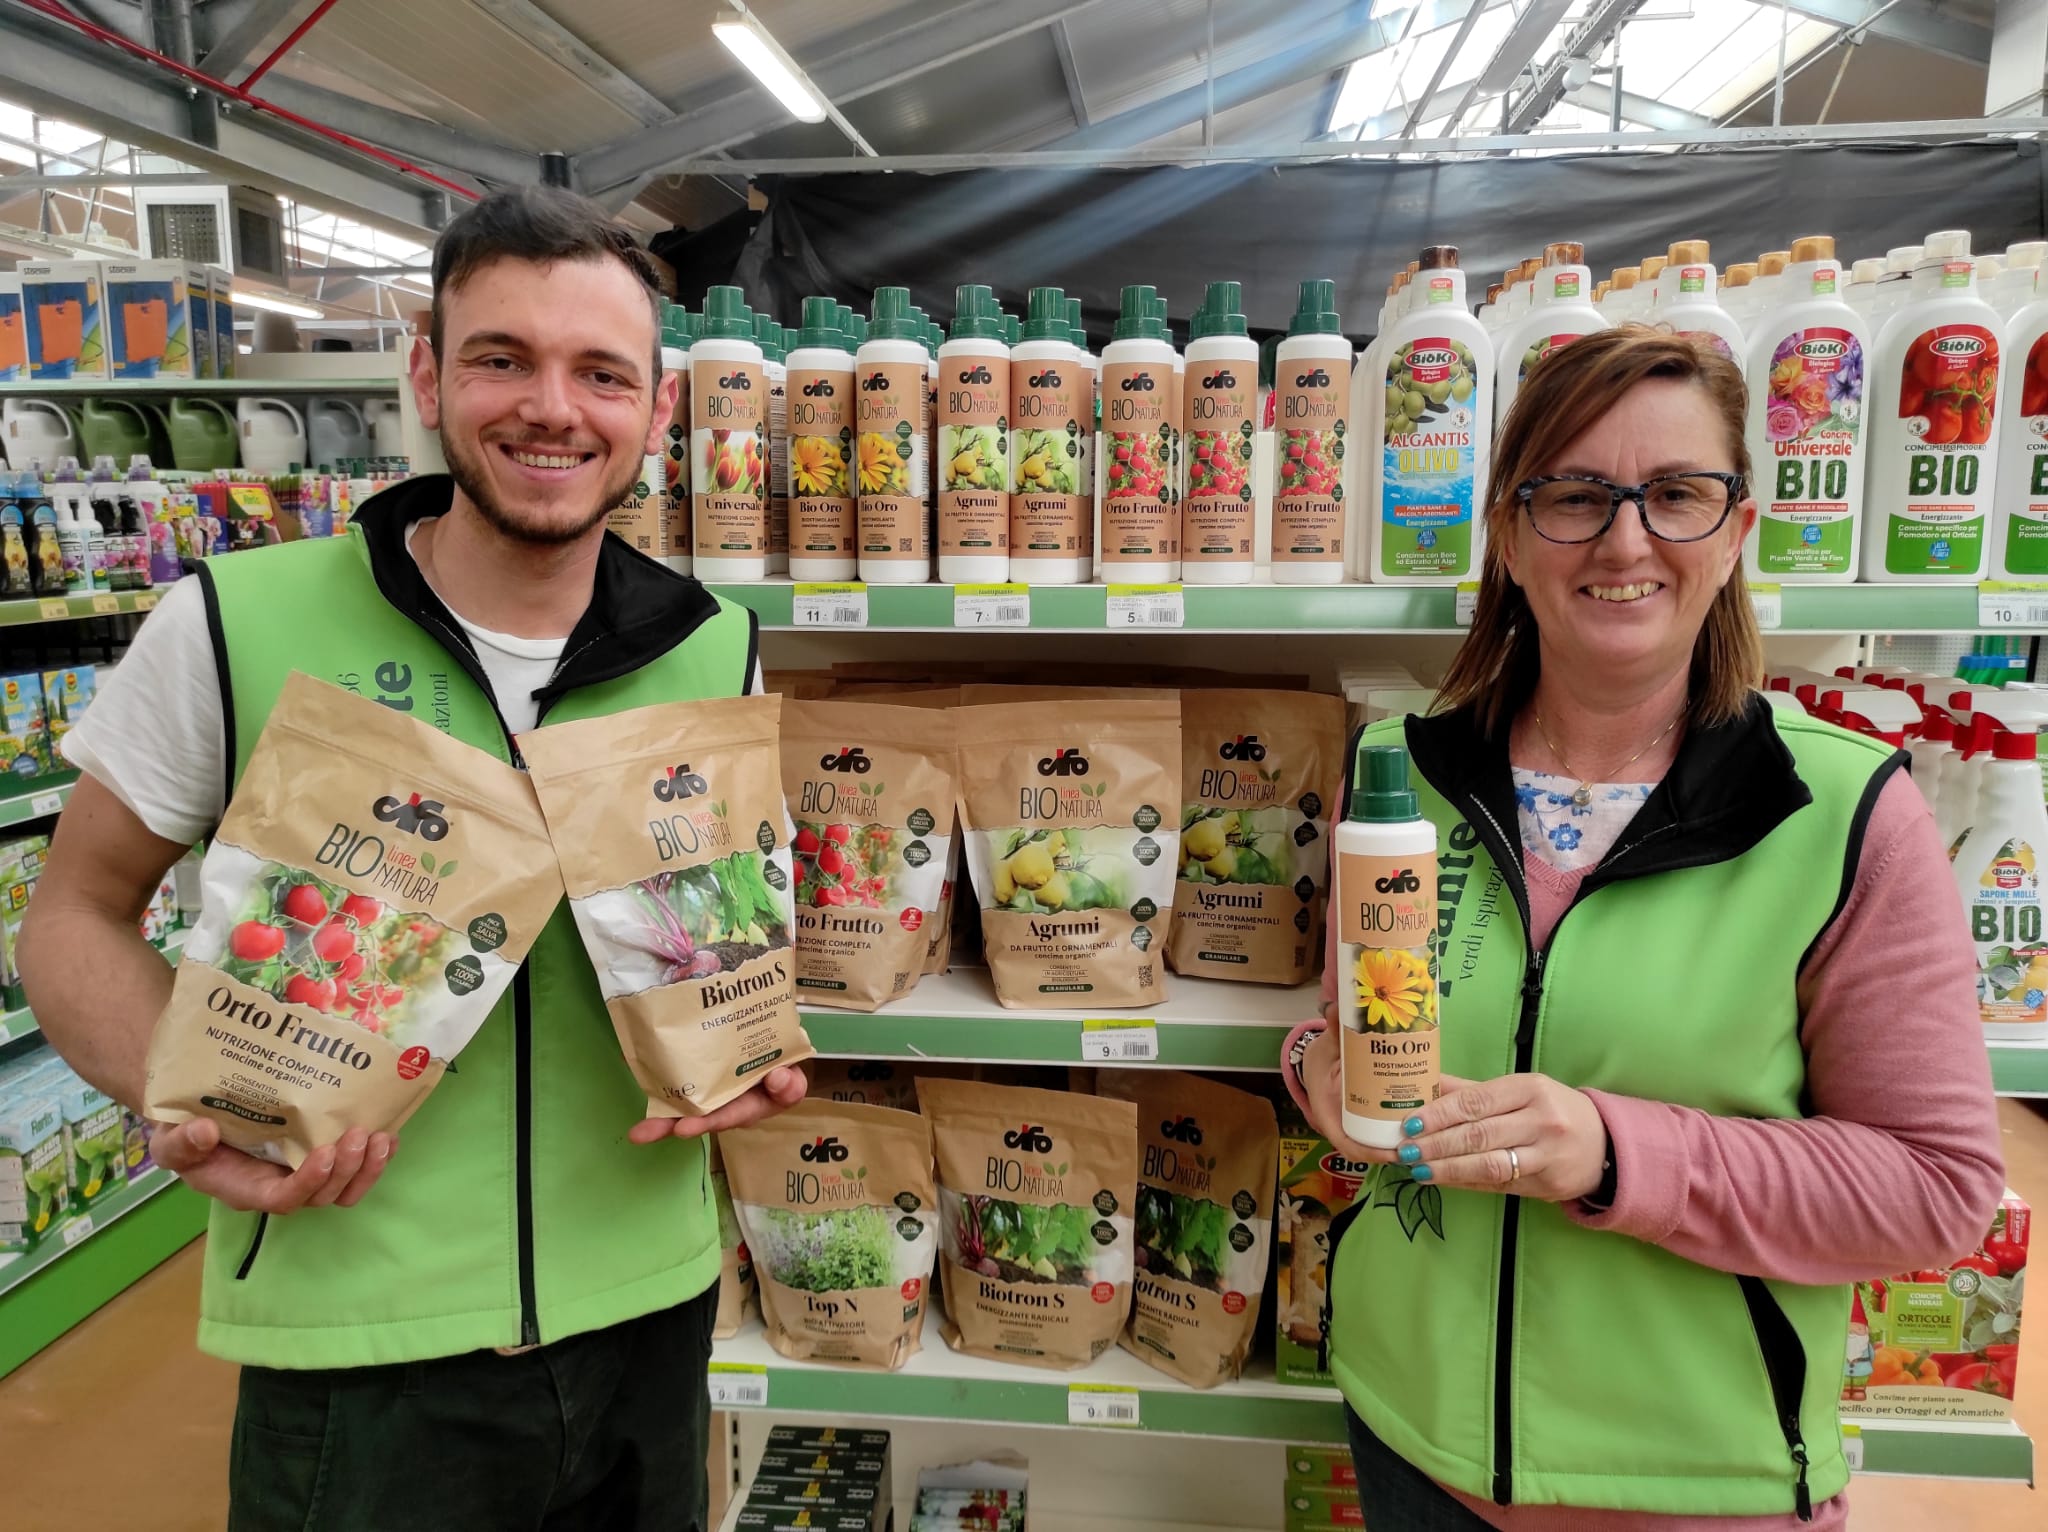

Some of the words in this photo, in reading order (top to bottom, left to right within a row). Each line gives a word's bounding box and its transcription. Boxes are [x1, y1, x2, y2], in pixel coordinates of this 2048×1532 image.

[719, 371, 751, 390] cifo
[862, 373, 890, 391] cifo
[959, 366, 992, 384] cifo
[1029, 370, 1062, 389] cifo
[1121, 372, 1154, 391] cifo
[1203, 370, 1236, 389] cifo
[1296, 368, 1330, 388] cifo
[803, 379, 834, 397] cifo
[708, 396, 732, 417] BIO
[950, 391, 971, 413] BIO
[974, 402, 999, 413] NATURA
[1020, 396, 1041, 417] BIO
[1043, 404, 1068, 416] NATURA
[1111, 399, 1134, 420] BIO
[1135, 405, 1161, 420] NATURA
[1193, 397, 1215, 419] BIO
[1216, 403, 1242, 417] NATURA
[1285, 396, 1309, 418] BIO
[1309, 404, 1336, 417] NATURA
[794, 404, 815, 424] BIO
[817, 412, 841, 424] NATURA
[871, 407, 898, 419] NATURA
[1392, 433, 1469, 448] ALGANTIS
[1821, 431, 1853, 439] Concime
[1774, 441, 1852, 457] Universale
[1400, 450, 1459, 473] OLIVO
[1776, 460, 1848, 500] BIO
[1909, 455, 1979, 496] BIO
[706, 499, 762, 511] Universale
[800, 502, 818, 512] Bio
[820, 502, 841, 512] Oro
[875, 501, 898, 512] Oro
[954, 496, 998, 511] Agrumi
[1023, 499, 1066, 513] Agrumi
[1106, 503, 1130, 513] Orto
[1133, 503, 1167, 514] Frutto
[1187, 503, 1211, 513] Orto
[1214, 503, 1248, 513] Frutto
[1278, 502, 1303, 512] Orto
[1306, 502, 1340, 512] Frutto
[806, 611, 819, 621] 11
[975, 612, 982, 622] 7
[1128, 612, 1135, 623] 5
[1995, 610, 2012, 621] 10
[430, 673, 450, 734] azioni
[1219, 735, 1266, 762] cifo
[820, 748, 871, 773] cifo
[1038, 749, 1089, 776] cifo
[654, 764, 707, 802] cifo
[838, 784, 857, 795] linea
[1060, 787, 1079, 798] linea
[1200, 769, 1237, 800] BIO
[1237, 782, 1276, 801] NATURA
[801, 781, 835, 814] BIO
[836, 797, 877, 817] NATURA
[1020, 787, 1058, 820] BIO
[373, 792, 449, 841] cifo
[1060, 799, 1103, 818] NATURA
[649, 815, 698, 861] BIO
[315, 823, 385, 878] BIO
[387, 845, 416, 869] linea
[373, 862, 439, 905] NATURA
[1375, 869, 1420, 894] cifo
[1192, 889, 1262, 910] Agrumi
[1437, 822, 1480, 997] iante
[796, 913, 816, 929] rto
[821, 914, 883, 934] Frutto
[1188, 912, 1216, 920] FRUTTO
[1224, 915, 1279, 925] ORNAMENTALI
[1361, 903, 1394, 932] BIO
[1397, 912, 1429, 931] NATURA
[1460, 936, 1484, 980] verdi
[1472, 866, 1503, 928] ispirazi
[1972, 906, 2042, 942] BIO
[476, 926, 496, 940] SALVA
[1026, 916, 1099, 942] Agrumi
[796, 936, 826, 945] RIZIONE
[829, 940, 871, 949] COMPLETA
[1062, 941, 1117, 951] ORNAMENTALI
[455, 969, 476, 983] 100%
[701, 971, 774, 1009] Biotron
[775, 962, 786, 982] S
[702, 1002, 763, 1030] ENERGIZZANTE
[736, 1011, 777, 1031] ammendante
[207, 987, 272, 1030] Orto
[275, 1013, 371, 1070] Frutto
[206, 1026, 277, 1061] NUTRIZIONE
[277, 1055, 341, 1088] COMPLETA
[1103, 1046, 1109, 1056] 9
[1371, 1040, 1397, 1055] Bio
[1402, 1040, 1430, 1055] Oro
[221, 1048, 264, 1070] concime
[266, 1066, 312, 1089] organico
[1374, 1061, 1428, 1069] BIOSTIMOLANTE
[229, 1082, 280, 1106] AGRICOLTURA
[231, 1073, 278, 1095] CONSENTITO
[213, 1099, 272, 1122] GRANULARE
[226, 1093, 267, 1111] BIOLOGICA
[1004, 1124, 1053, 1153] cifo
[1161, 1115, 1203, 1145] cifo
[800, 1136, 848, 1163] cifo
[1143, 1145, 1177, 1182] BIO
[1178, 1165, 1210, 1192] NATURA
[1331, 1158, 1369, 1172] BIO
[986, 1156, 1021, 1192] BIO
[1023, 1174, 1064, 1197] NATURA
[787, 1170, 819, 1204] BIO
[822, 1183, 865, 1200] NATURA
[980, 1281, 1048, 1307] Biotron
[1053, 1292, 1064, 1308] S
[1185, 1294, 1195, 1310] S
[804, 1296, 838, 1318] Top
[845, 1298, 857, 1314] N
[1032, 1313, 1069, 1323] RADICALE
[1164, 1312, 1200, 1328] RADICALE
[1898, 1315, 1951, 1323] ORTICOLE
[1873, 1393, 1905, 1402] Concime
[1923, 1395, 1945, 1403] piante
[1087, 1407, 1095, 1418] 9
[1876, 1406, 1891, 1414] per
[1895, 1407, 1931, 1416] Ortaggi
[1935, 1407, 1946, 1415] ed
[1950, 1408, 2004, 1417] Aromatiche
